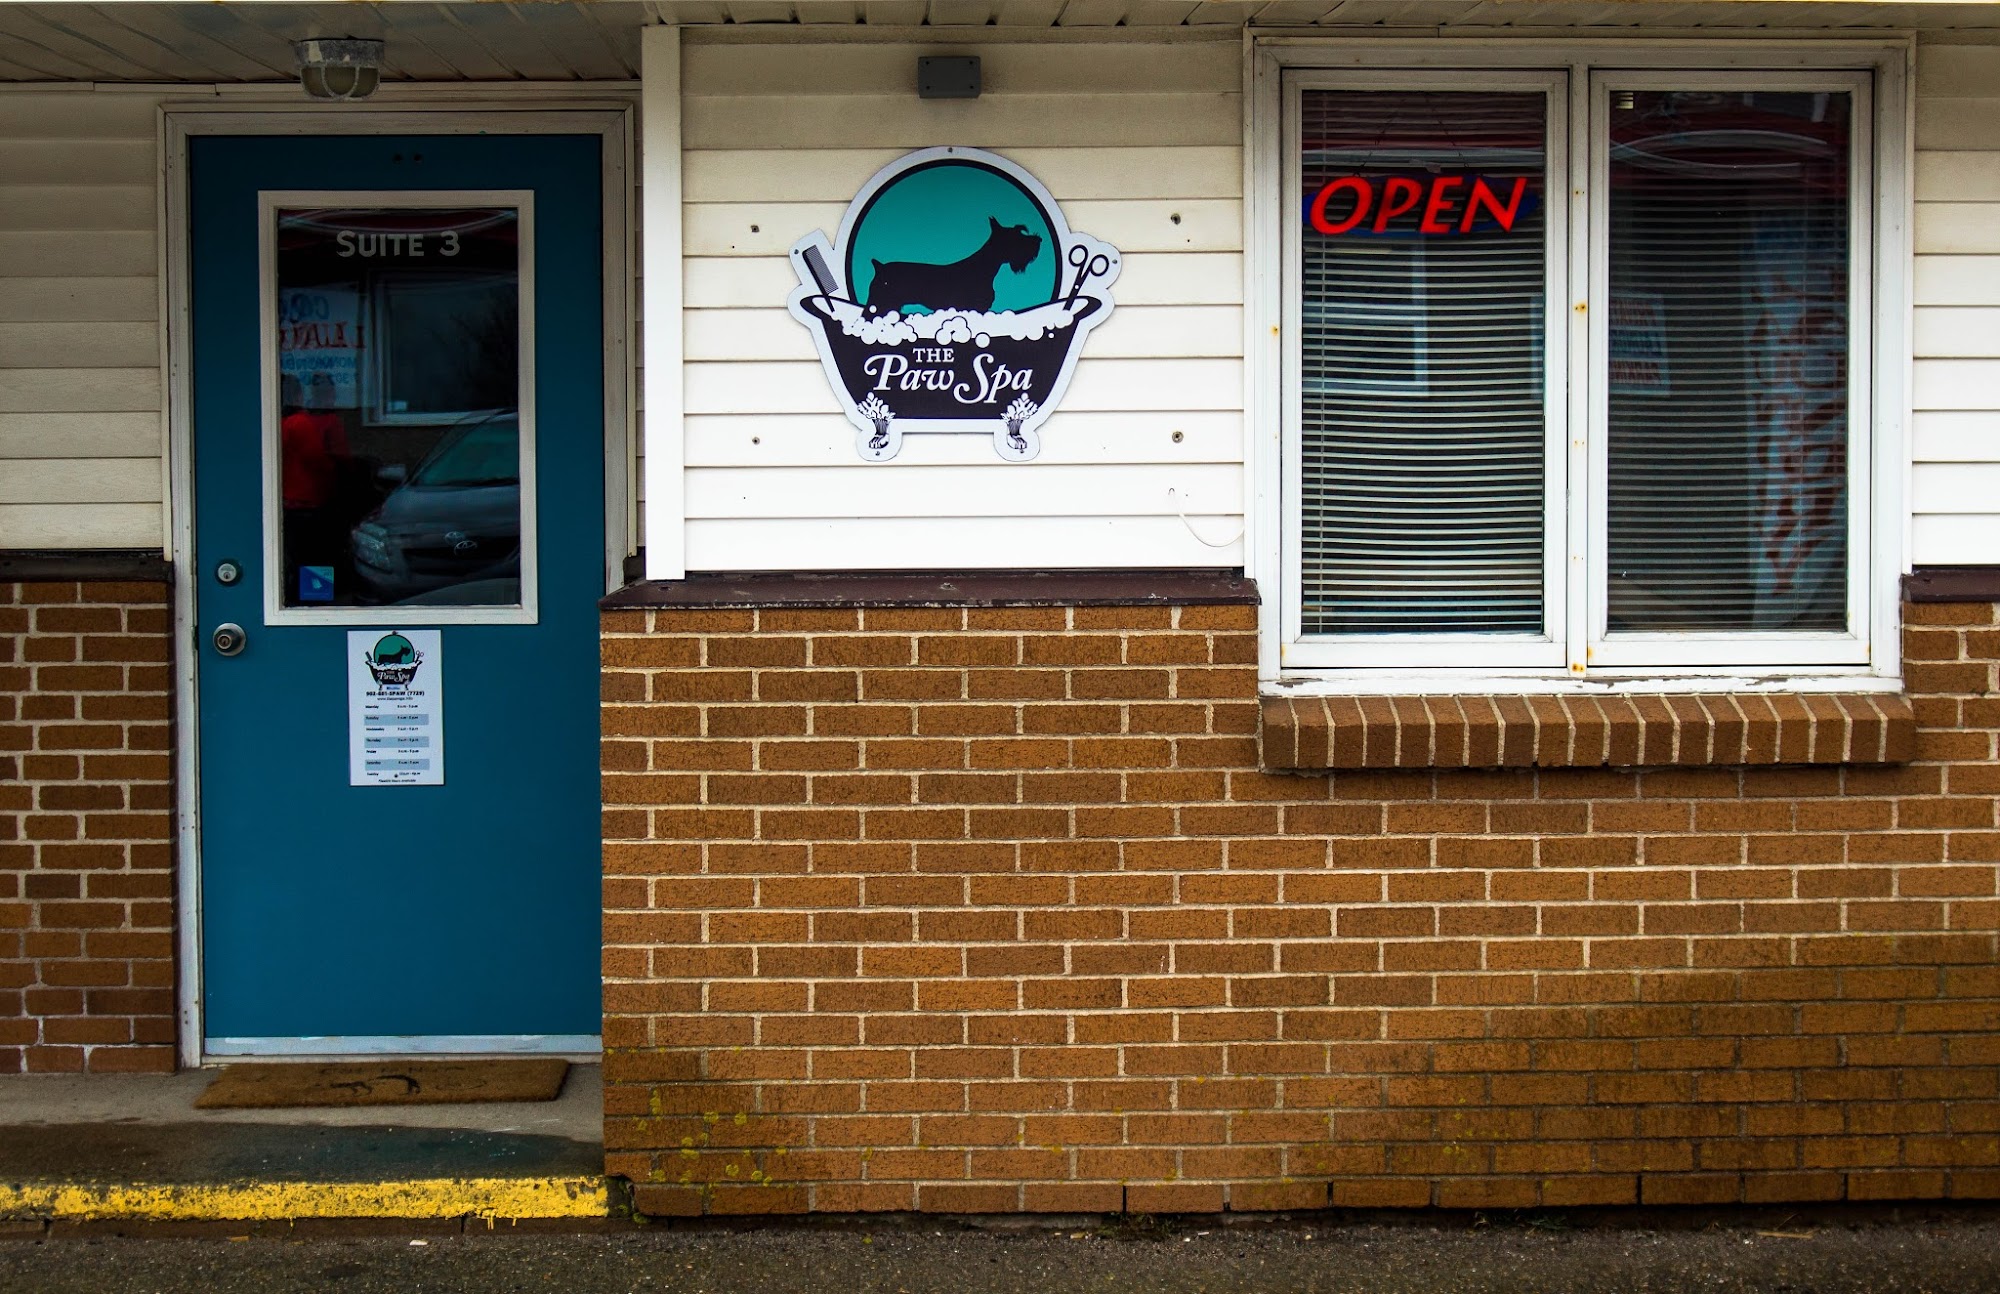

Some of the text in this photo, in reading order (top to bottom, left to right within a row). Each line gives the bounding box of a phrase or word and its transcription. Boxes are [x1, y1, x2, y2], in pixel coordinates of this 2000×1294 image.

[1309, 175, 1529, 235] OPEN
[336, 230, 461, 258] SUITE 3
[912, 348, 955, 363] THE
[863, 353, 1034, 404] Paw Spa
